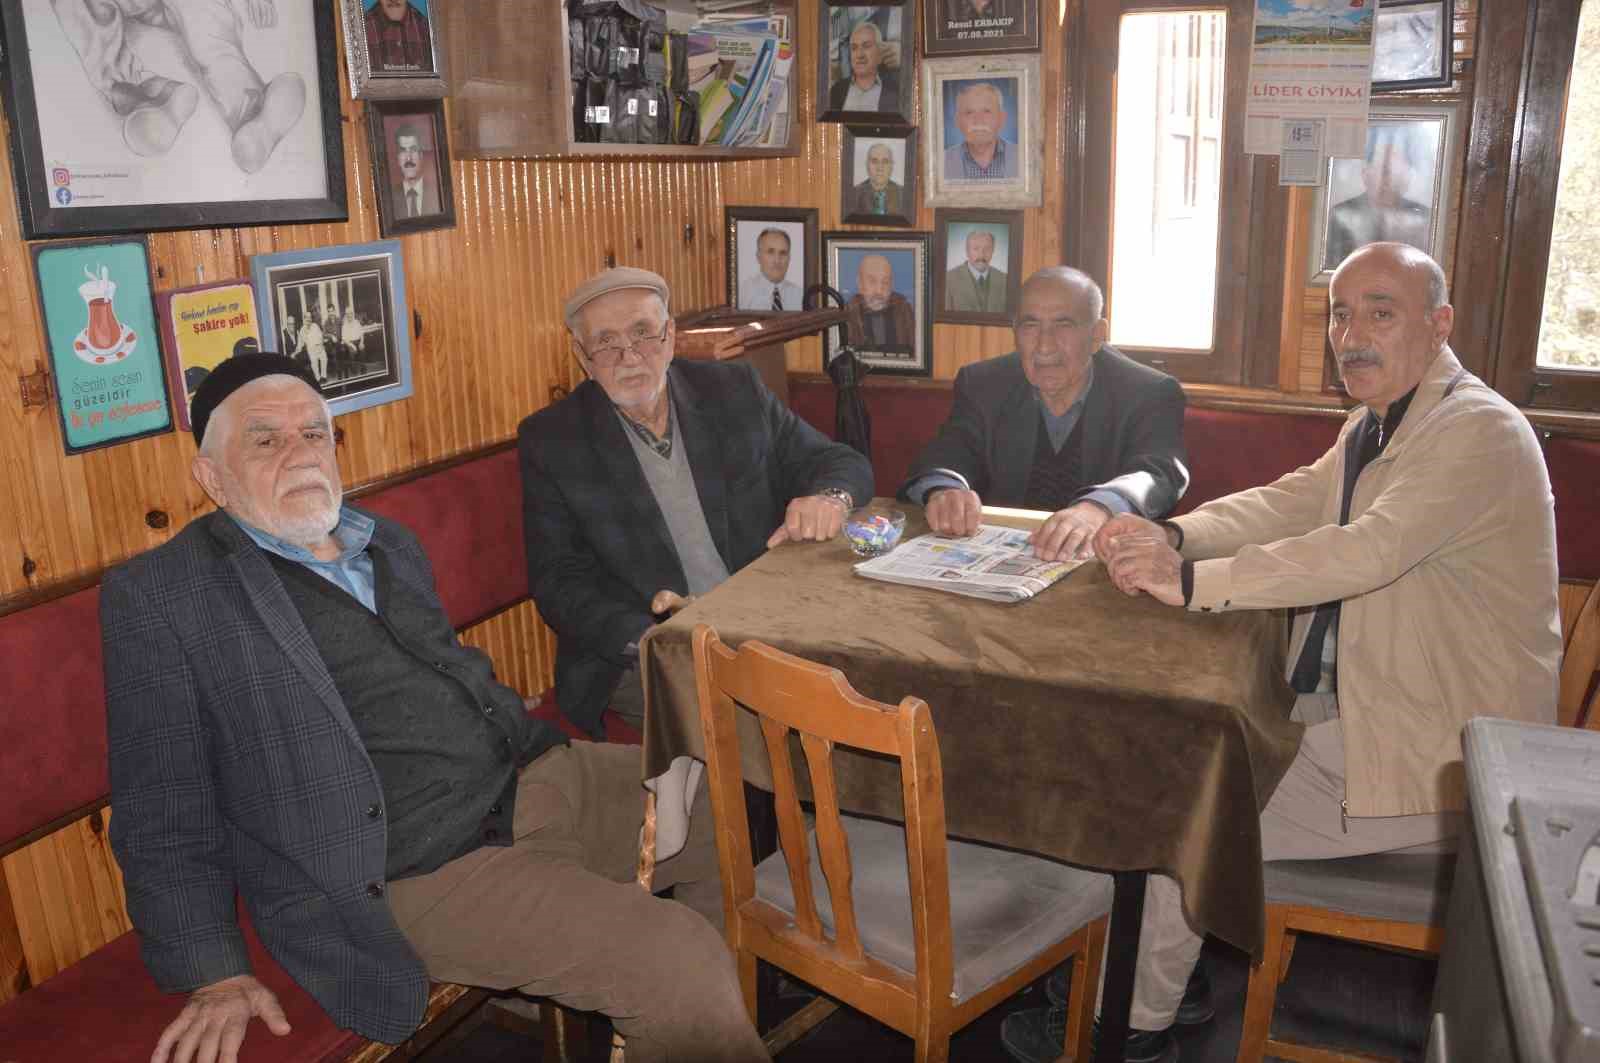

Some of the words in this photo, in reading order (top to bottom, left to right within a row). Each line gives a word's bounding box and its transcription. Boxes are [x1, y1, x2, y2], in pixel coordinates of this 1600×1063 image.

[1253, 83, 1303, 97] LİDER
[1307, 84, 1363, 98] GİYİM
[74, 390, 129, 409] güzeldir
